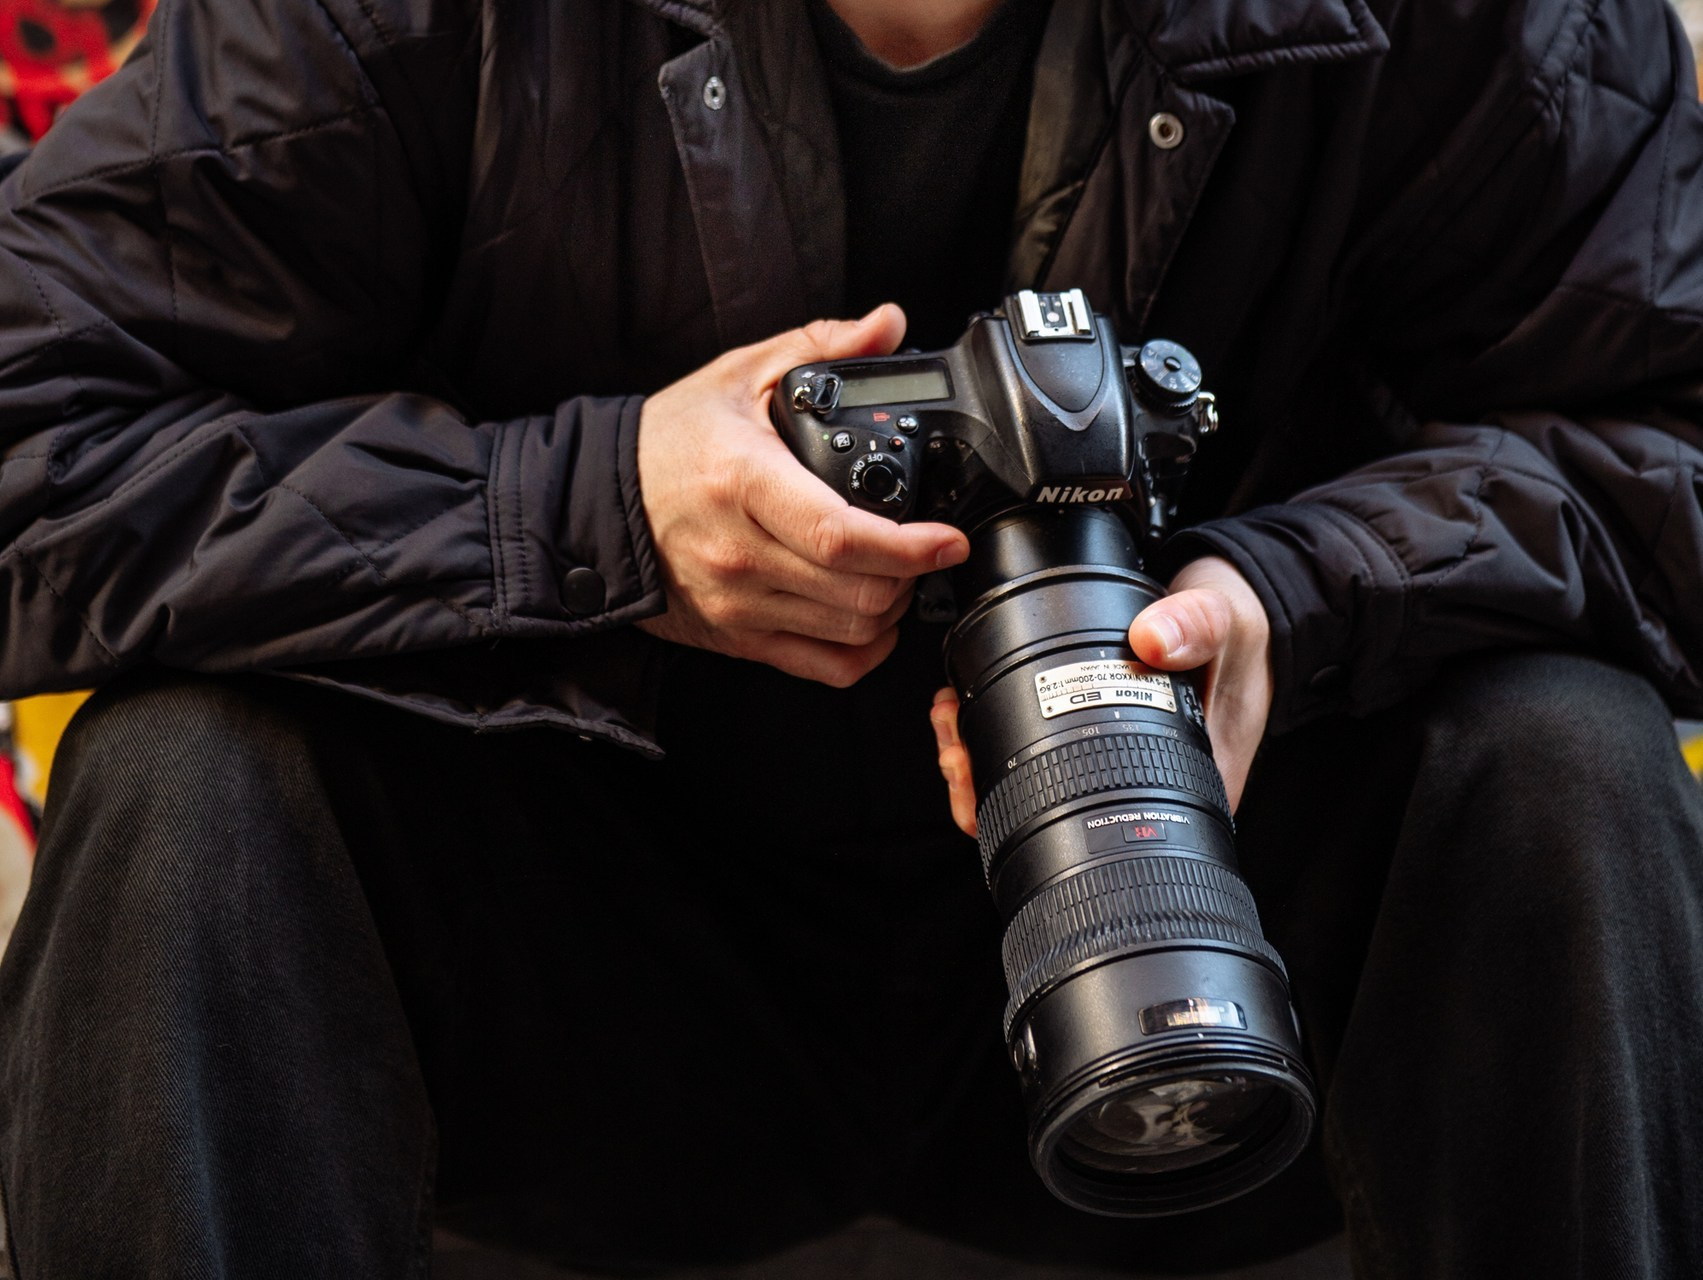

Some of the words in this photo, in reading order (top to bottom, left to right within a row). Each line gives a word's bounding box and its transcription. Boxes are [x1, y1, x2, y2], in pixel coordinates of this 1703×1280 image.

[867, 453, 883, 463] OFF
[853, 460, 865, 473] ON
[1036, 486, 1124, 503] Nikon
[1064, 672, 1107, 685] 70-200mm
[1039, 680, 1064, 694] 1:2.8G
[1069, 691, 1102, 705] ED
[1115, 689, 1153, 702] Nikon
[1082, 726, 1100, 737] 105
[1007, 757, 1018, 769] 70
[1087, 812, 1141, 829] REDUCTION
[1143, 811, 1191, 825] VIBRATION
[1134, 825, 1158, 839] VR
